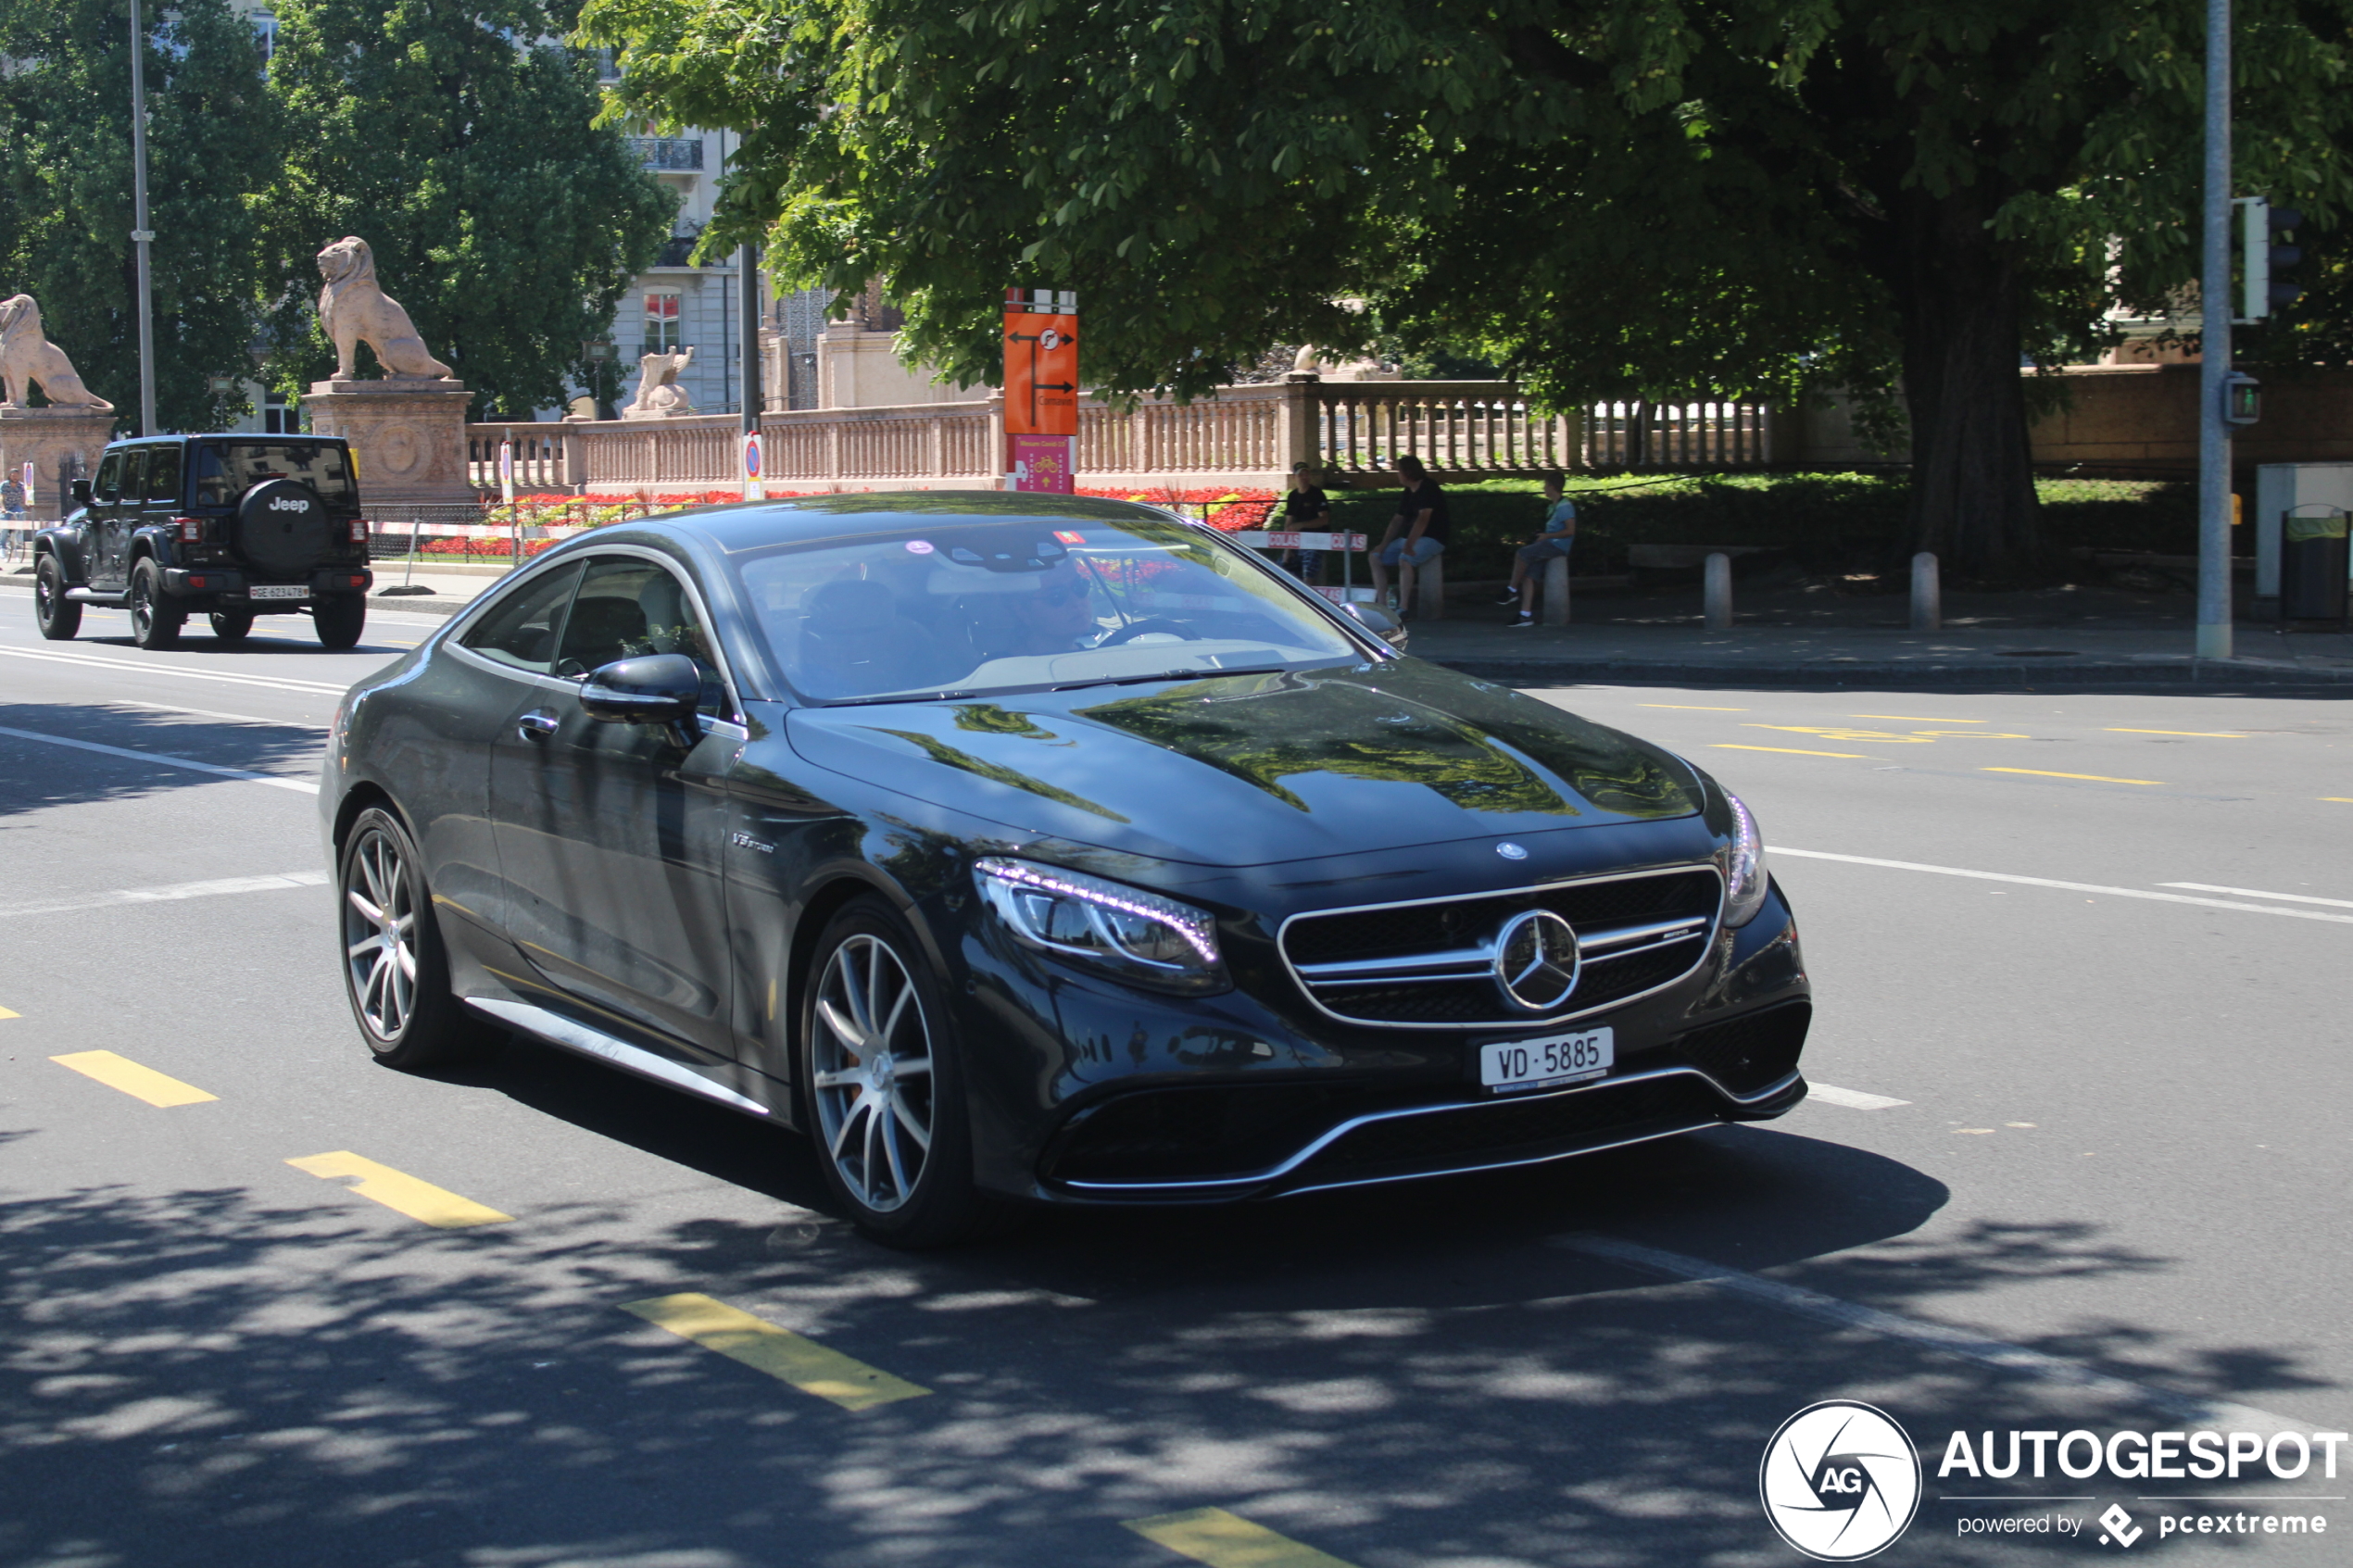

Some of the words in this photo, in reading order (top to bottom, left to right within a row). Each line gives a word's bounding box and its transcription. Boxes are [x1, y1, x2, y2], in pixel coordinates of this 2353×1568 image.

[1038, 395, 1073, 406] Cornavin
[269, 496, 309, 514] Jeep
[1269, 532, 1300, 548] COLAS
[1331, 533, 1366, 550] COAS
